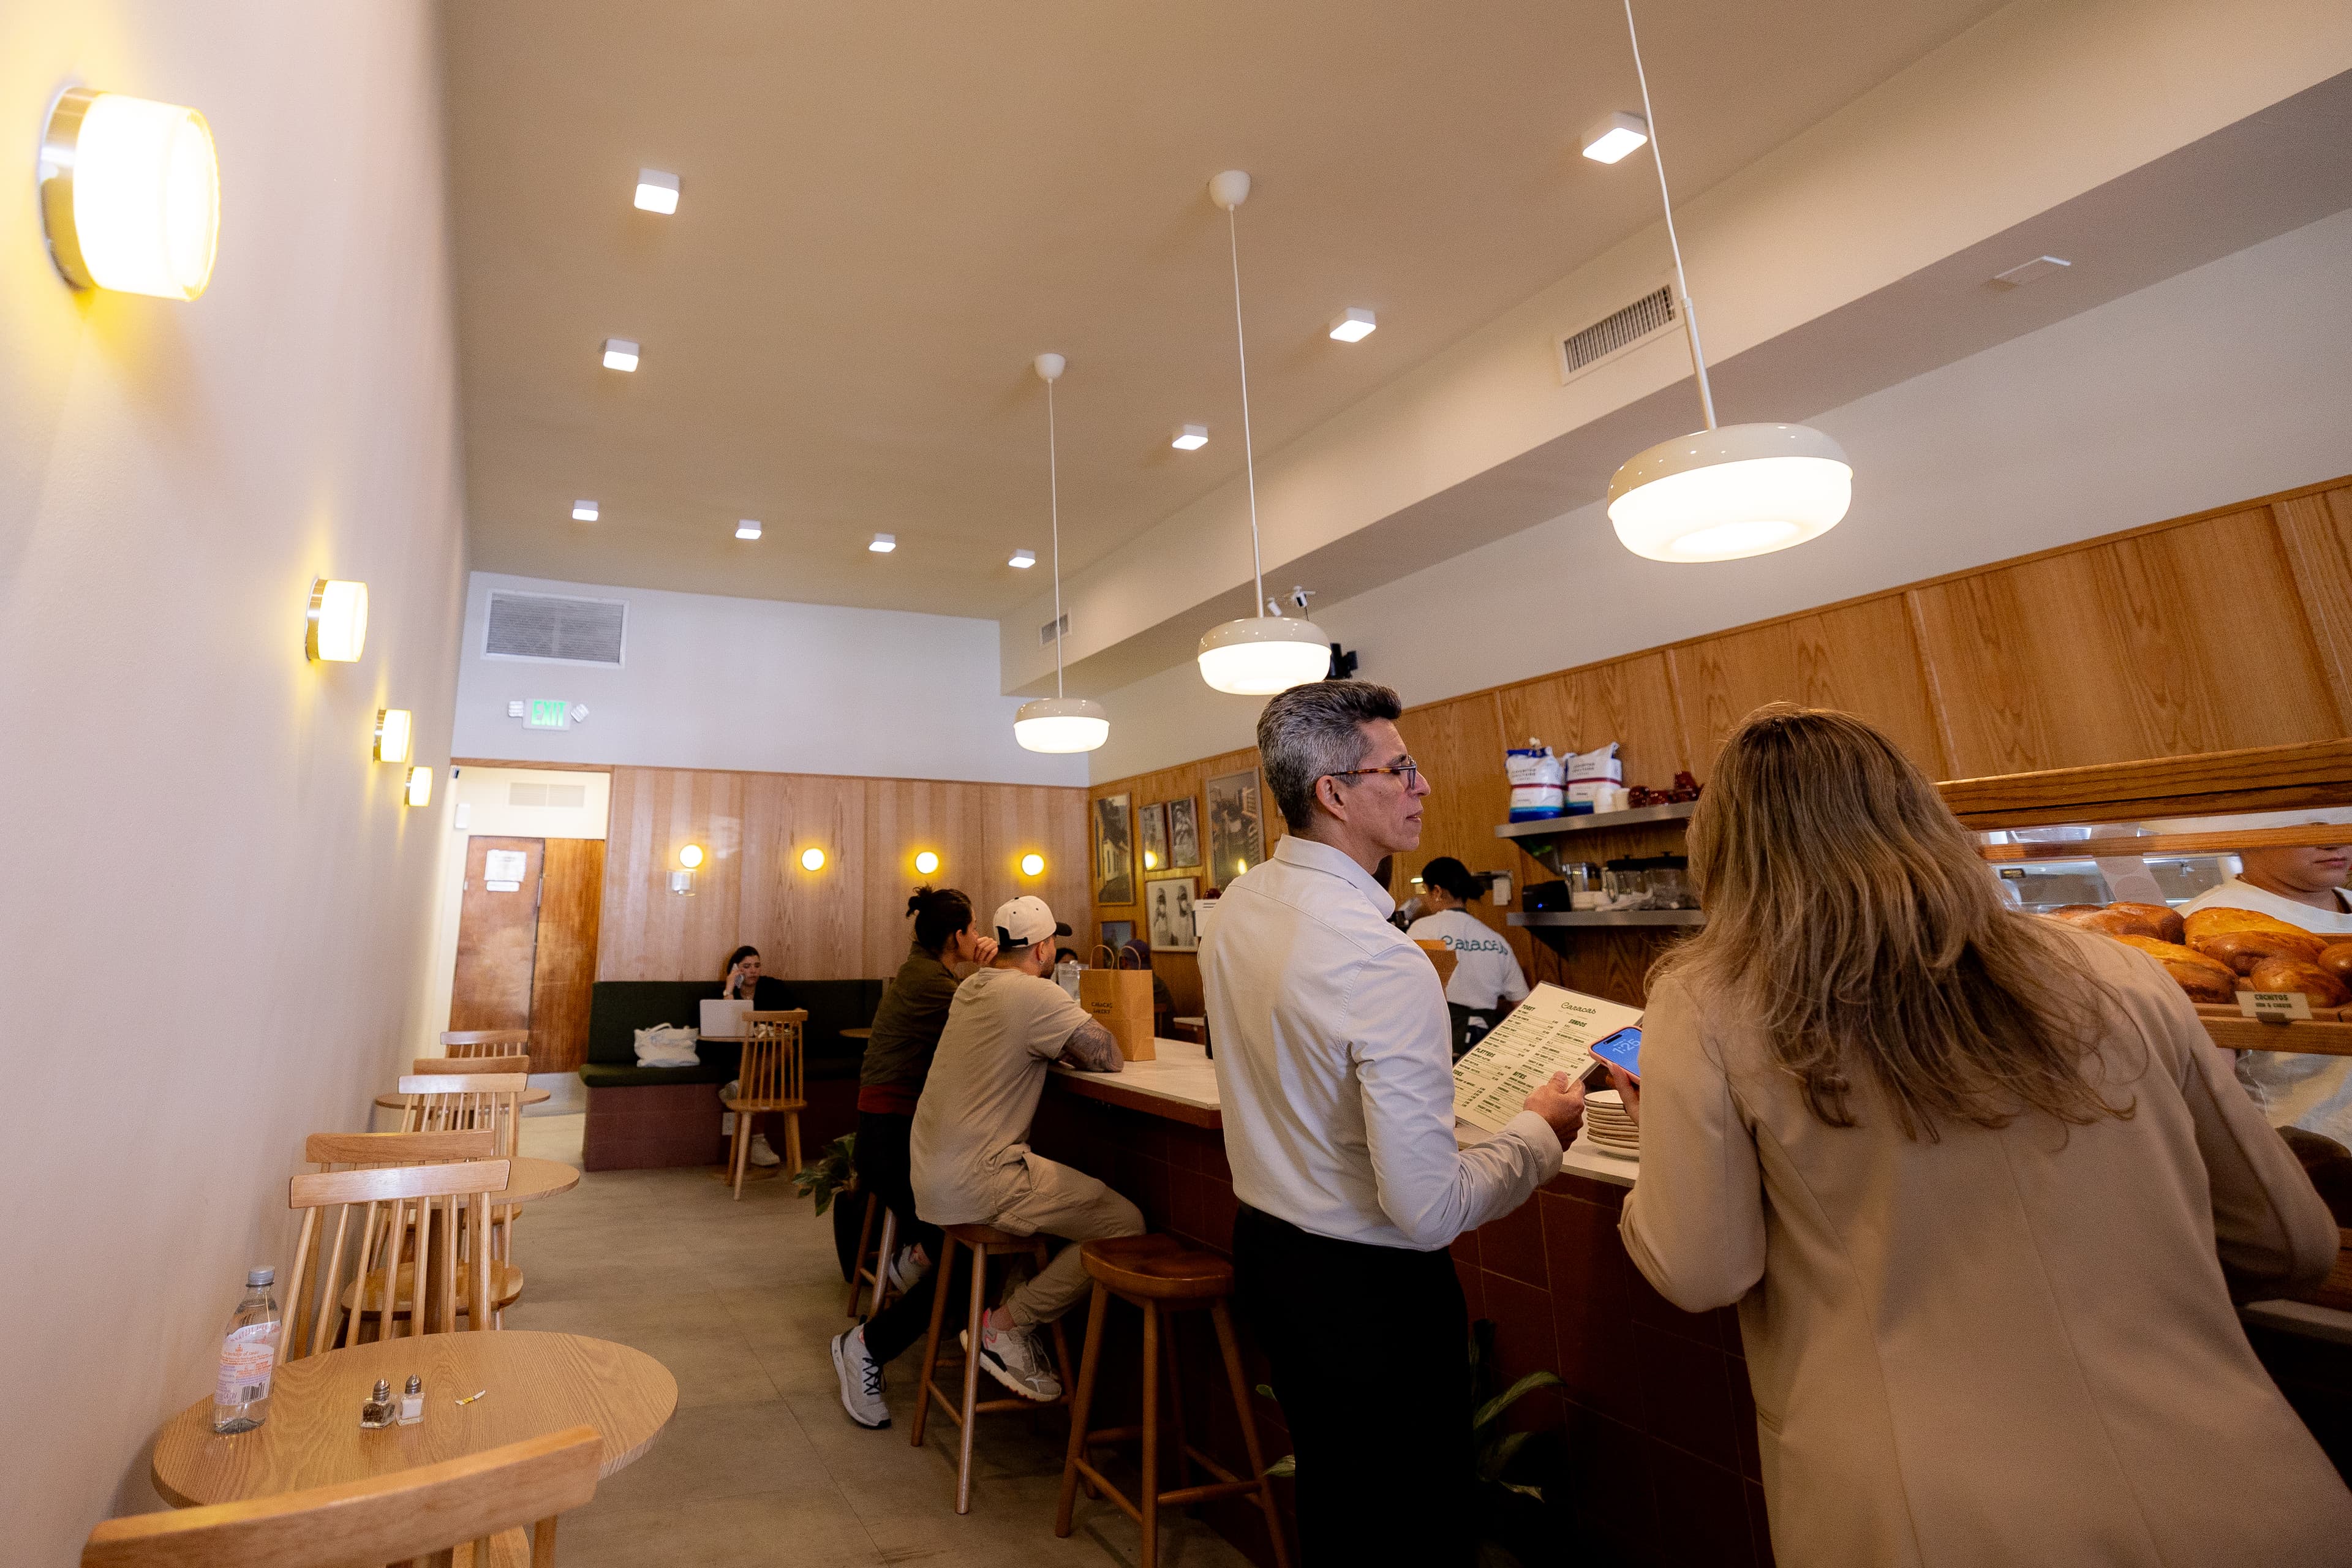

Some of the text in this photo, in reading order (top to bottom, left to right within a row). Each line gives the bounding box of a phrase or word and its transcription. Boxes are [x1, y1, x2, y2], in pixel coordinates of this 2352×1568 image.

[531, 699, 567, 726] EXIT
[1561, 1002, 1597, 1014] Caracas
[1613, 1038, 1640, 1054] 1:25
